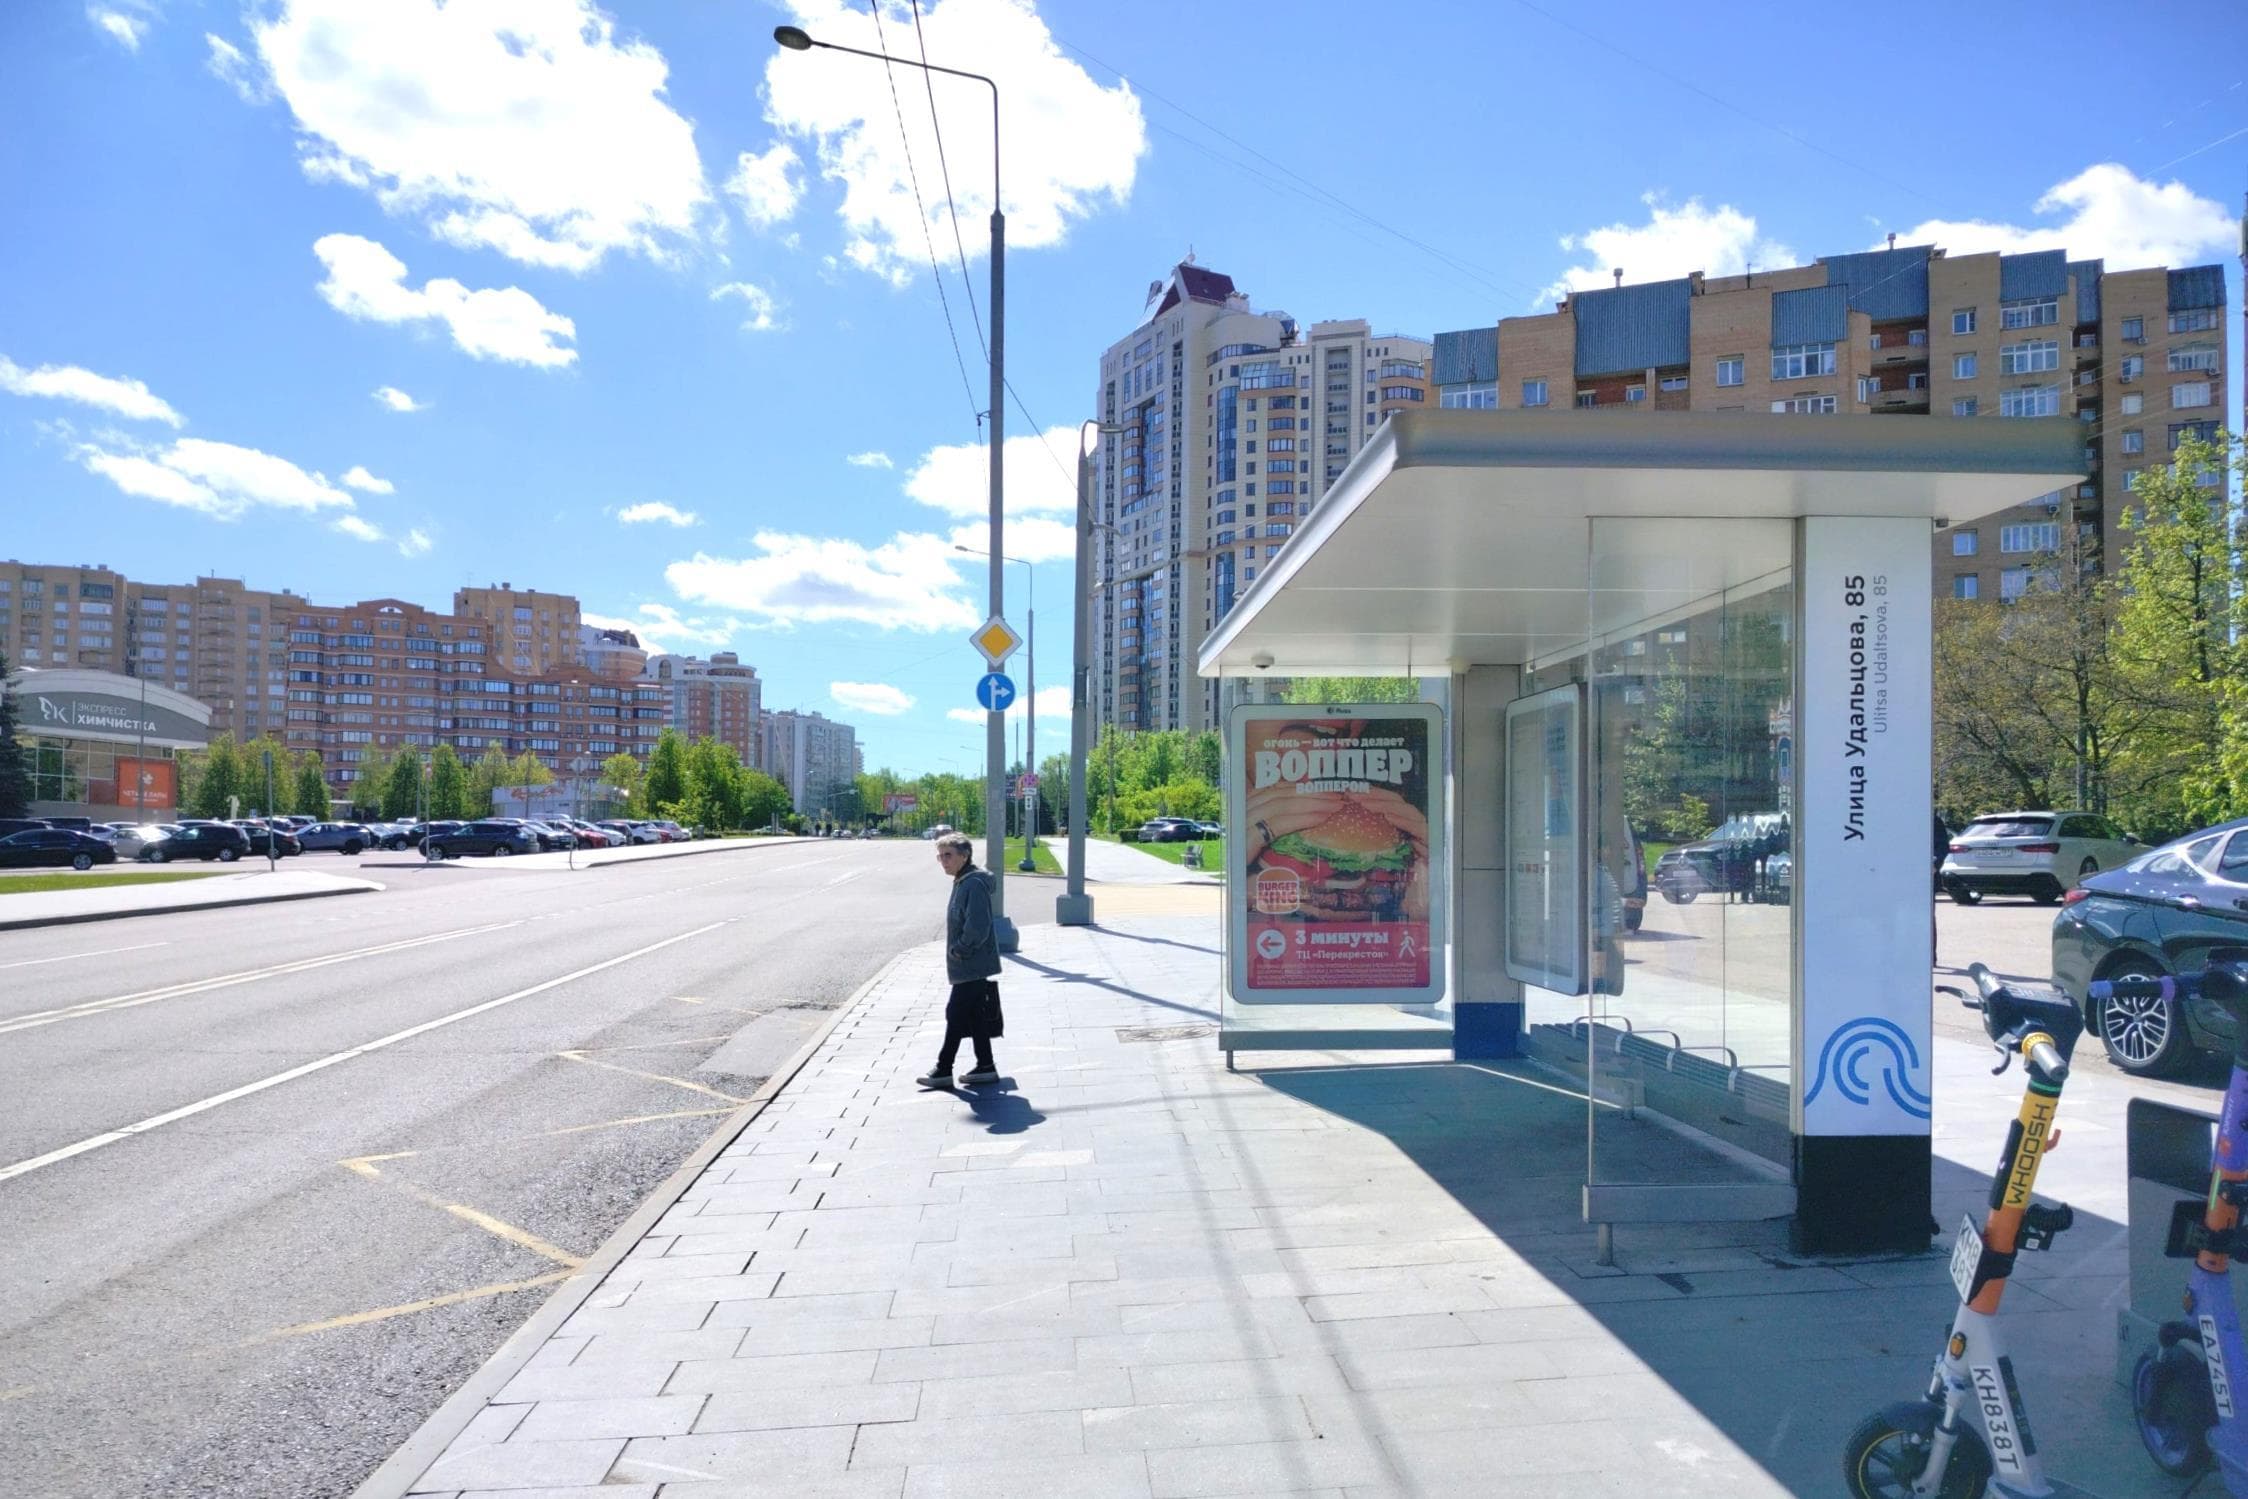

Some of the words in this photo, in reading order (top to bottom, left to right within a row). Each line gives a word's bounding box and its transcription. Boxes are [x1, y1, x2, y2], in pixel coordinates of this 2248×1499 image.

[1844, 575, 1865, 607] 85
[1873, 575, 1888, 596] 85
[1873, 601, 1889, 684] Udaltsova,
[1844, 614, 1869, 758] Удальцова,
[77, 703, 127, 717] ЭКСПРЕСС
[77, 714, 157, 732] ХИМЧИСТКА
[1873, 689, 1888, 734] Ulitsa
[1312, 737, 1335, 748] вот
[1336, 737, 1359, 748] что
[1360, 736, 1406, 748] делает
[1255, 749, 1413, 789] ВОППЕР
[1295, 779, 1371, 795] ВОППЕРОМ
[1844, 765, 1867, 841] Улица
[1258, 881, 1298, 891] BURGER
[1295, 929, 1307, 945] 3
[1310, 930, 1389, 948] минуты
[1296, 950, 1311, 961] ТЦ
[2006, 1102, 2050, 1205] WHOOSH
[2200, 1319, 2233, 1415] EA745T
[1972, 1366, 2020, 1471] KH838T
